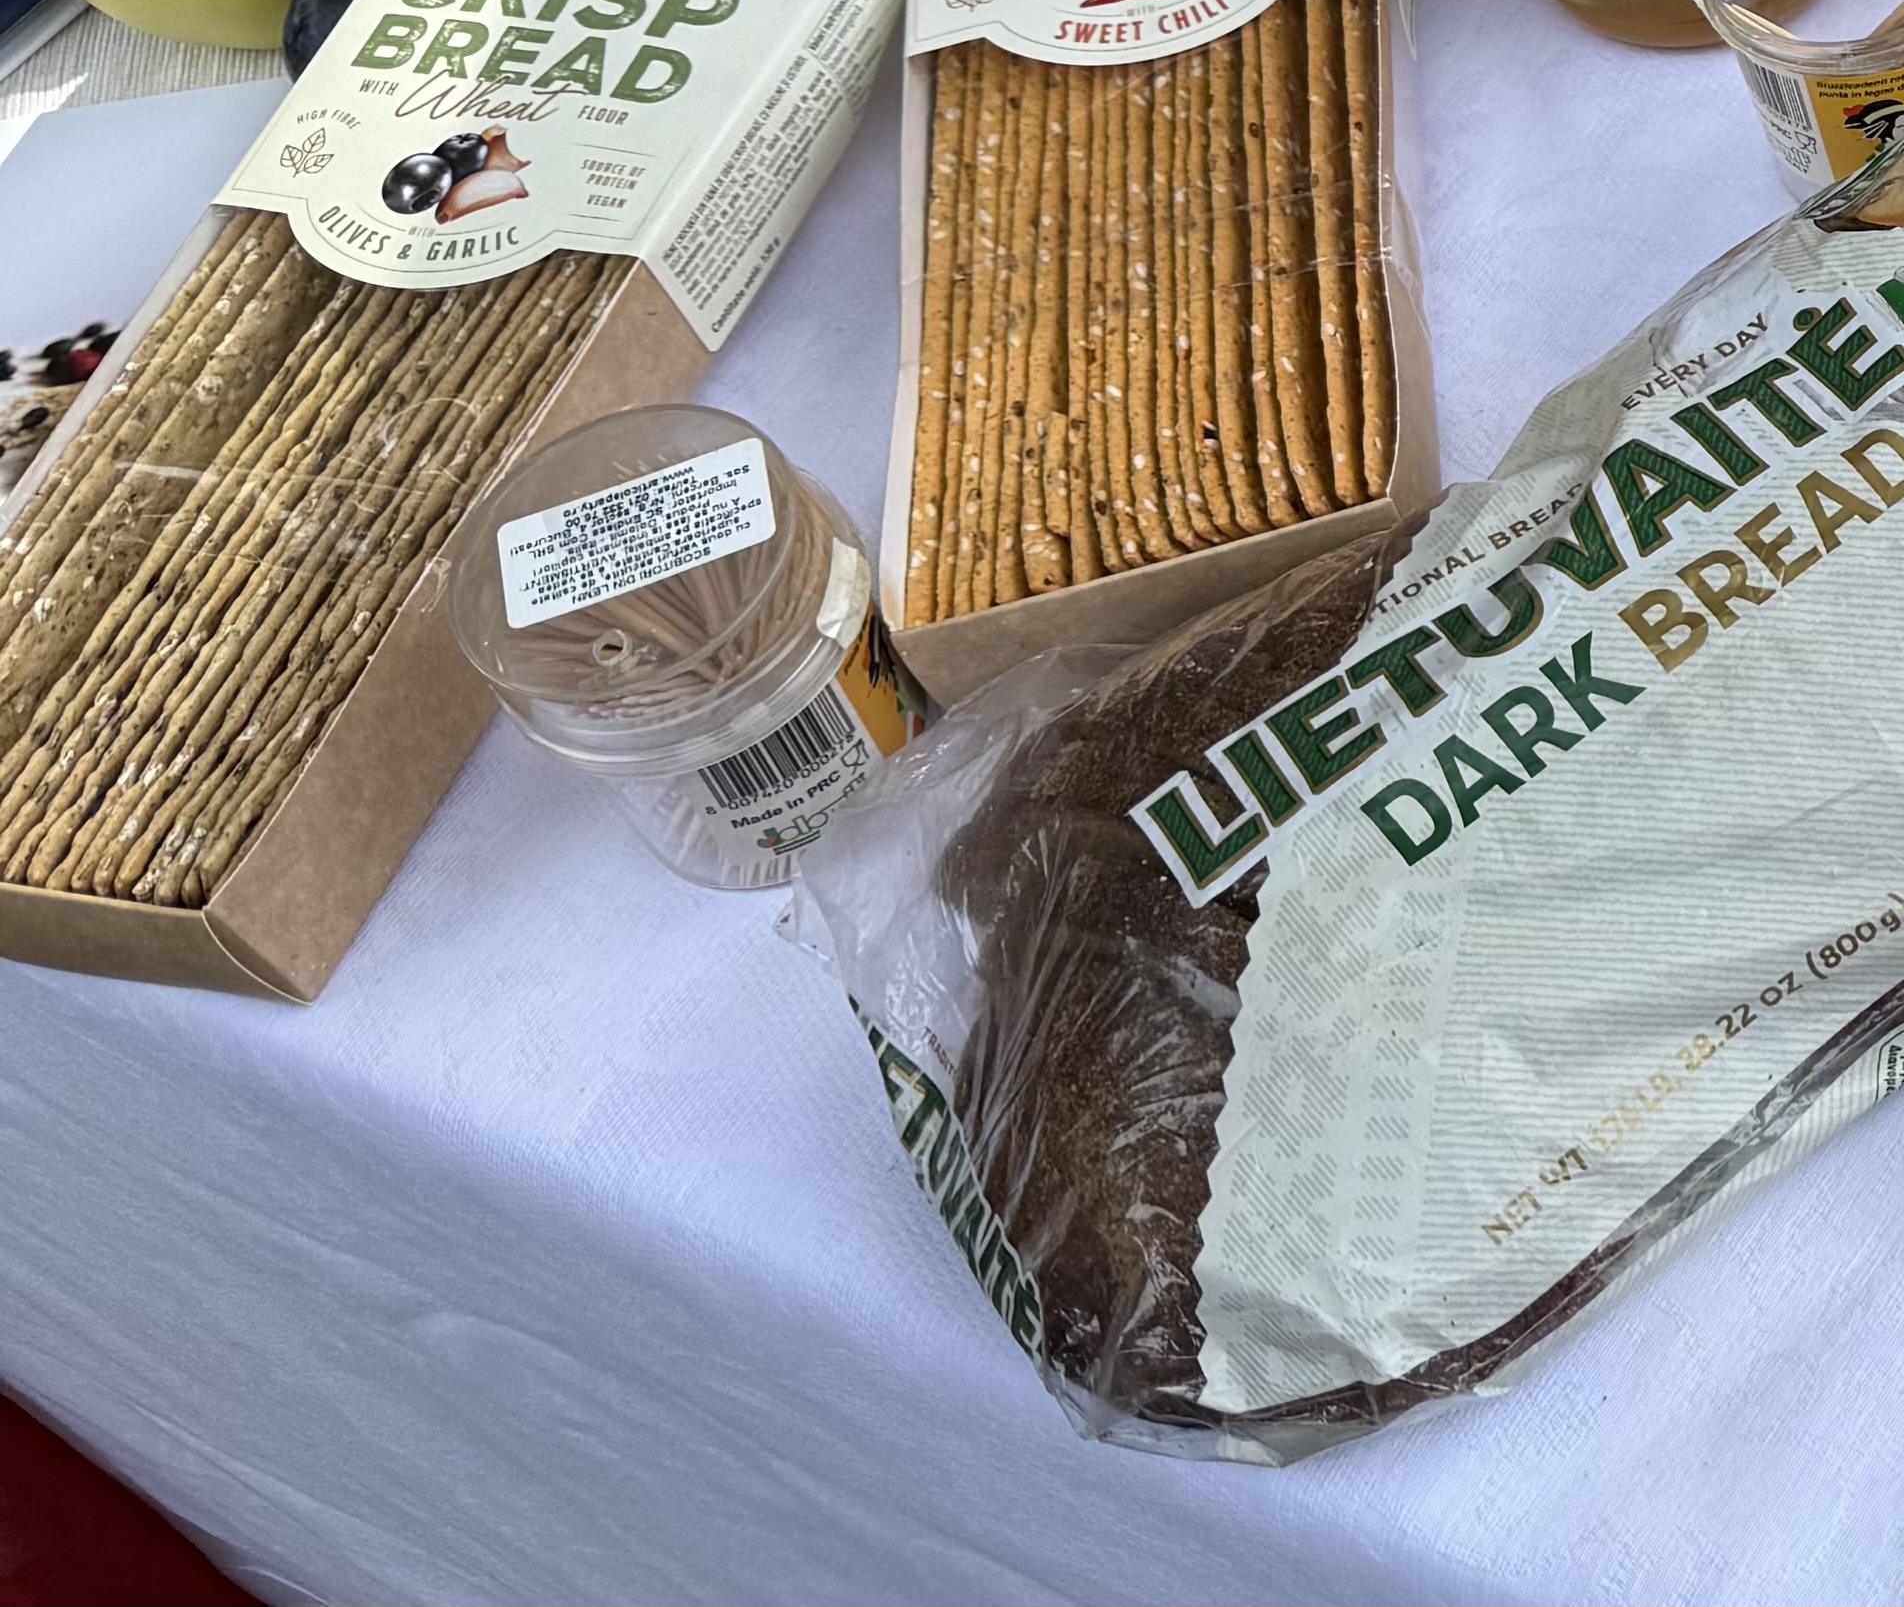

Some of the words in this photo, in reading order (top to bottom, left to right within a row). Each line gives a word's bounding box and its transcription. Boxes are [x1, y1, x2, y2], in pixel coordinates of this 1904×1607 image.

[1054, 19, 1144, 45] SWEET
[351, 13, 692, 105] BREAD
[359, 77, 400, 98] WITH
[394, 68, 587, 125] Wheat
[577, 105, 629, 128] FLOUR
[1818, 87, 1850, 101] punta
[1850, 89, 1863, 99] in
[1863, 83, 1894, 100] legno
[296, 106, 325, 125] HIGH
[581, 158, 625, 177] SOURCE
[630, 165, 646, 179] OF
[586, 173, 638, 191] PROTEIN
[587, 192, 626, 210] VEGAN
[318, 205, 390, 255] OLIVES
[396, 240, 412, 260] &
[426, 225, 520, 263] GARLIC
[1620, 350, 1715, 413] EVERY
[1716, 311, 1770, 360] DAY
[735, 521, 750, 531] cu
[558, 533, 588, 548] Com
[639, 546, 710, 579] SCOBITORI
[571, 583, 609, 603] LEMN
[612, 574, 635, 589] DIN
[1360, 631, 1647, 868] DARK
[731, 804, 784, 830] Made
[786, 794, 805, 809] in
[806, 770, 842, 800] PRC
[1478, 1186, 1547, 1249] NET
[1536, 1145, 1591, 1196] WT
[1757, 969, 1805, 1012] OZ
